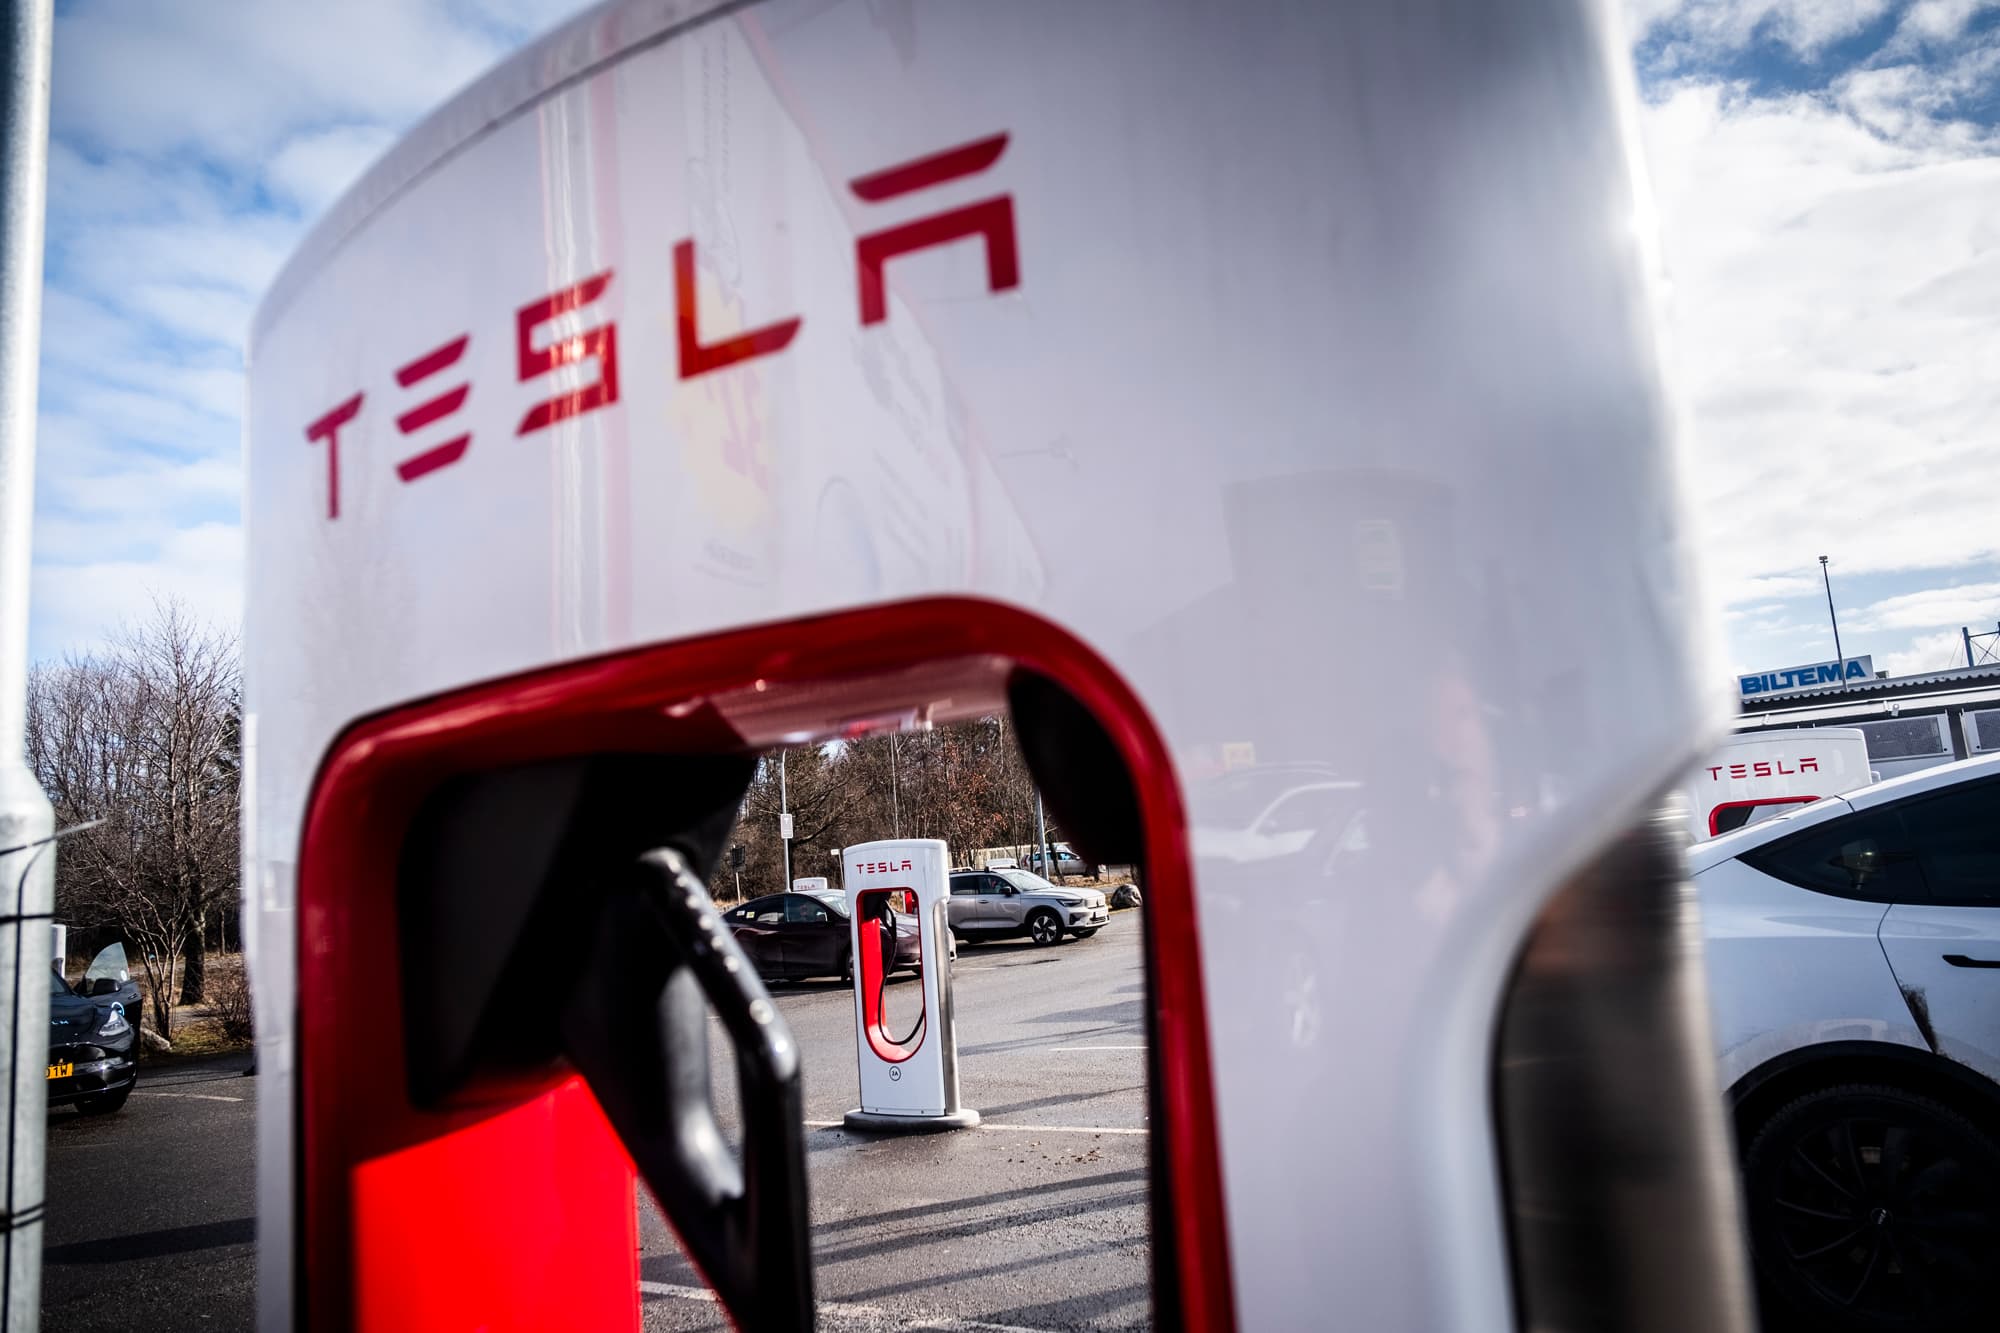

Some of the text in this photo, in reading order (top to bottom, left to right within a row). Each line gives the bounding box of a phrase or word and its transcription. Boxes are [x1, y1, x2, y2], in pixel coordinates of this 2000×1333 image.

[305, 130, 1020, 520] TESLA
[1741, 660, 1866, 695] BILTEMA
[1705, 757, 1818, 781] TESLA
[856, 860, 912, 874] TESLA
